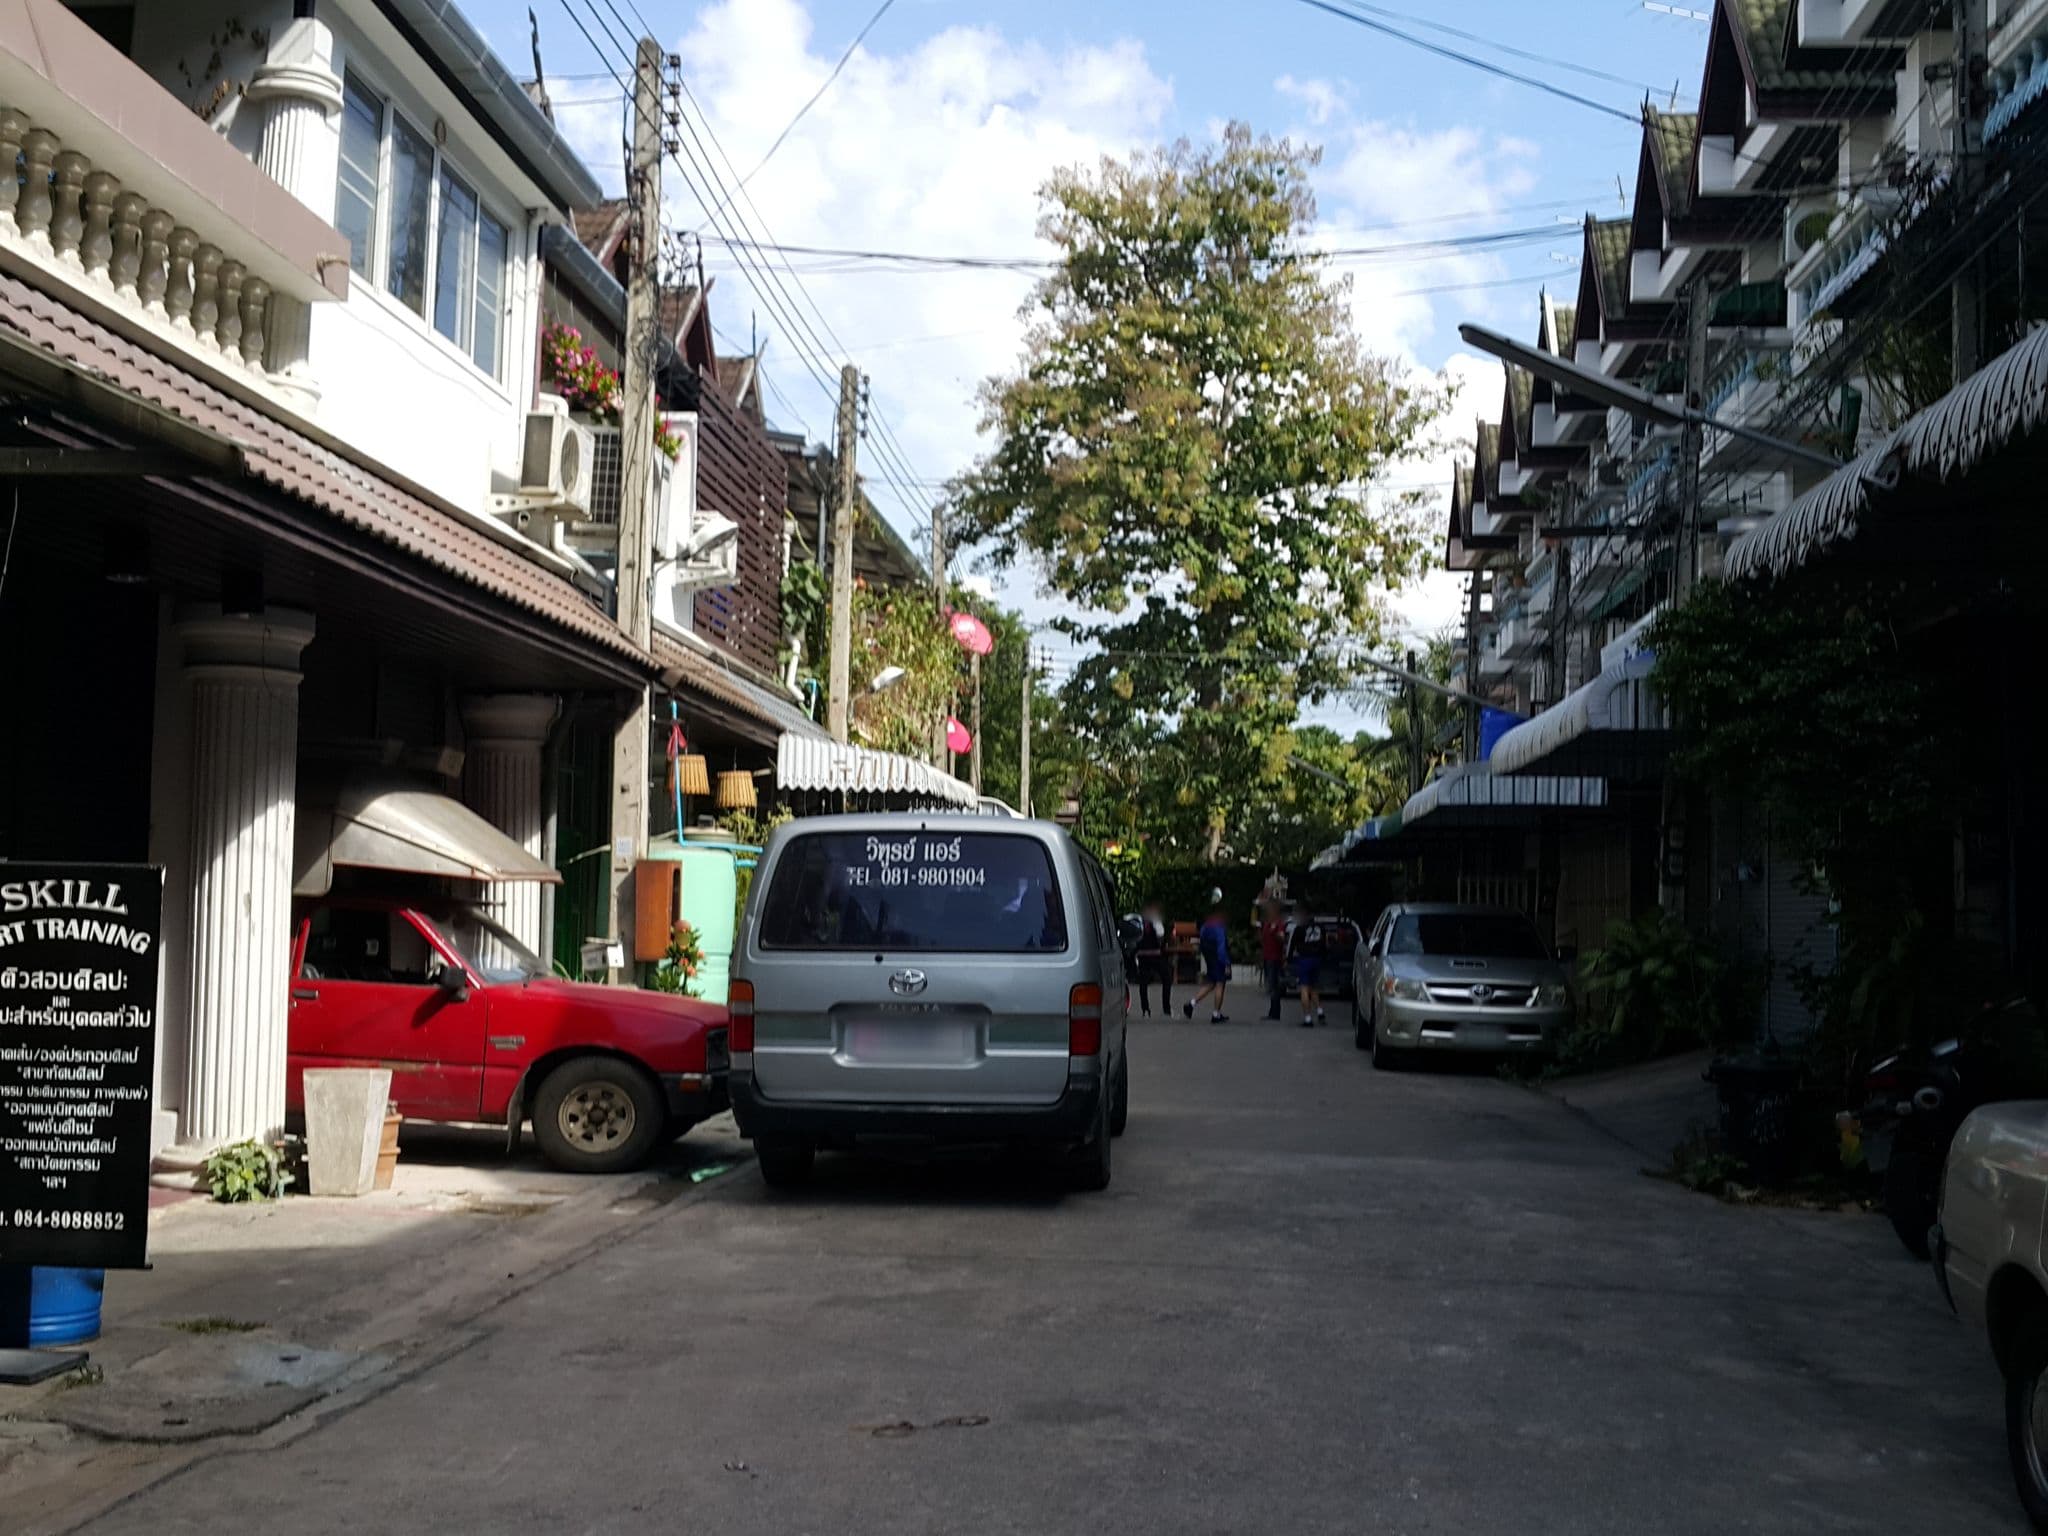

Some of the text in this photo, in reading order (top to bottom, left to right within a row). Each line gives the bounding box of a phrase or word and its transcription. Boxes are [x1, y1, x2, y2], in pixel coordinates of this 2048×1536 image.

[924, 836, 962, 862] แอร์
[881, 866, 986, 887] 081-9801904
[0, 879, 128, 915] SKILL
[32, 918, 151, 955] TRAINING
[52, 995, 71, 1008] และ
[14, 1209, 125, 1230] 084-8088852
